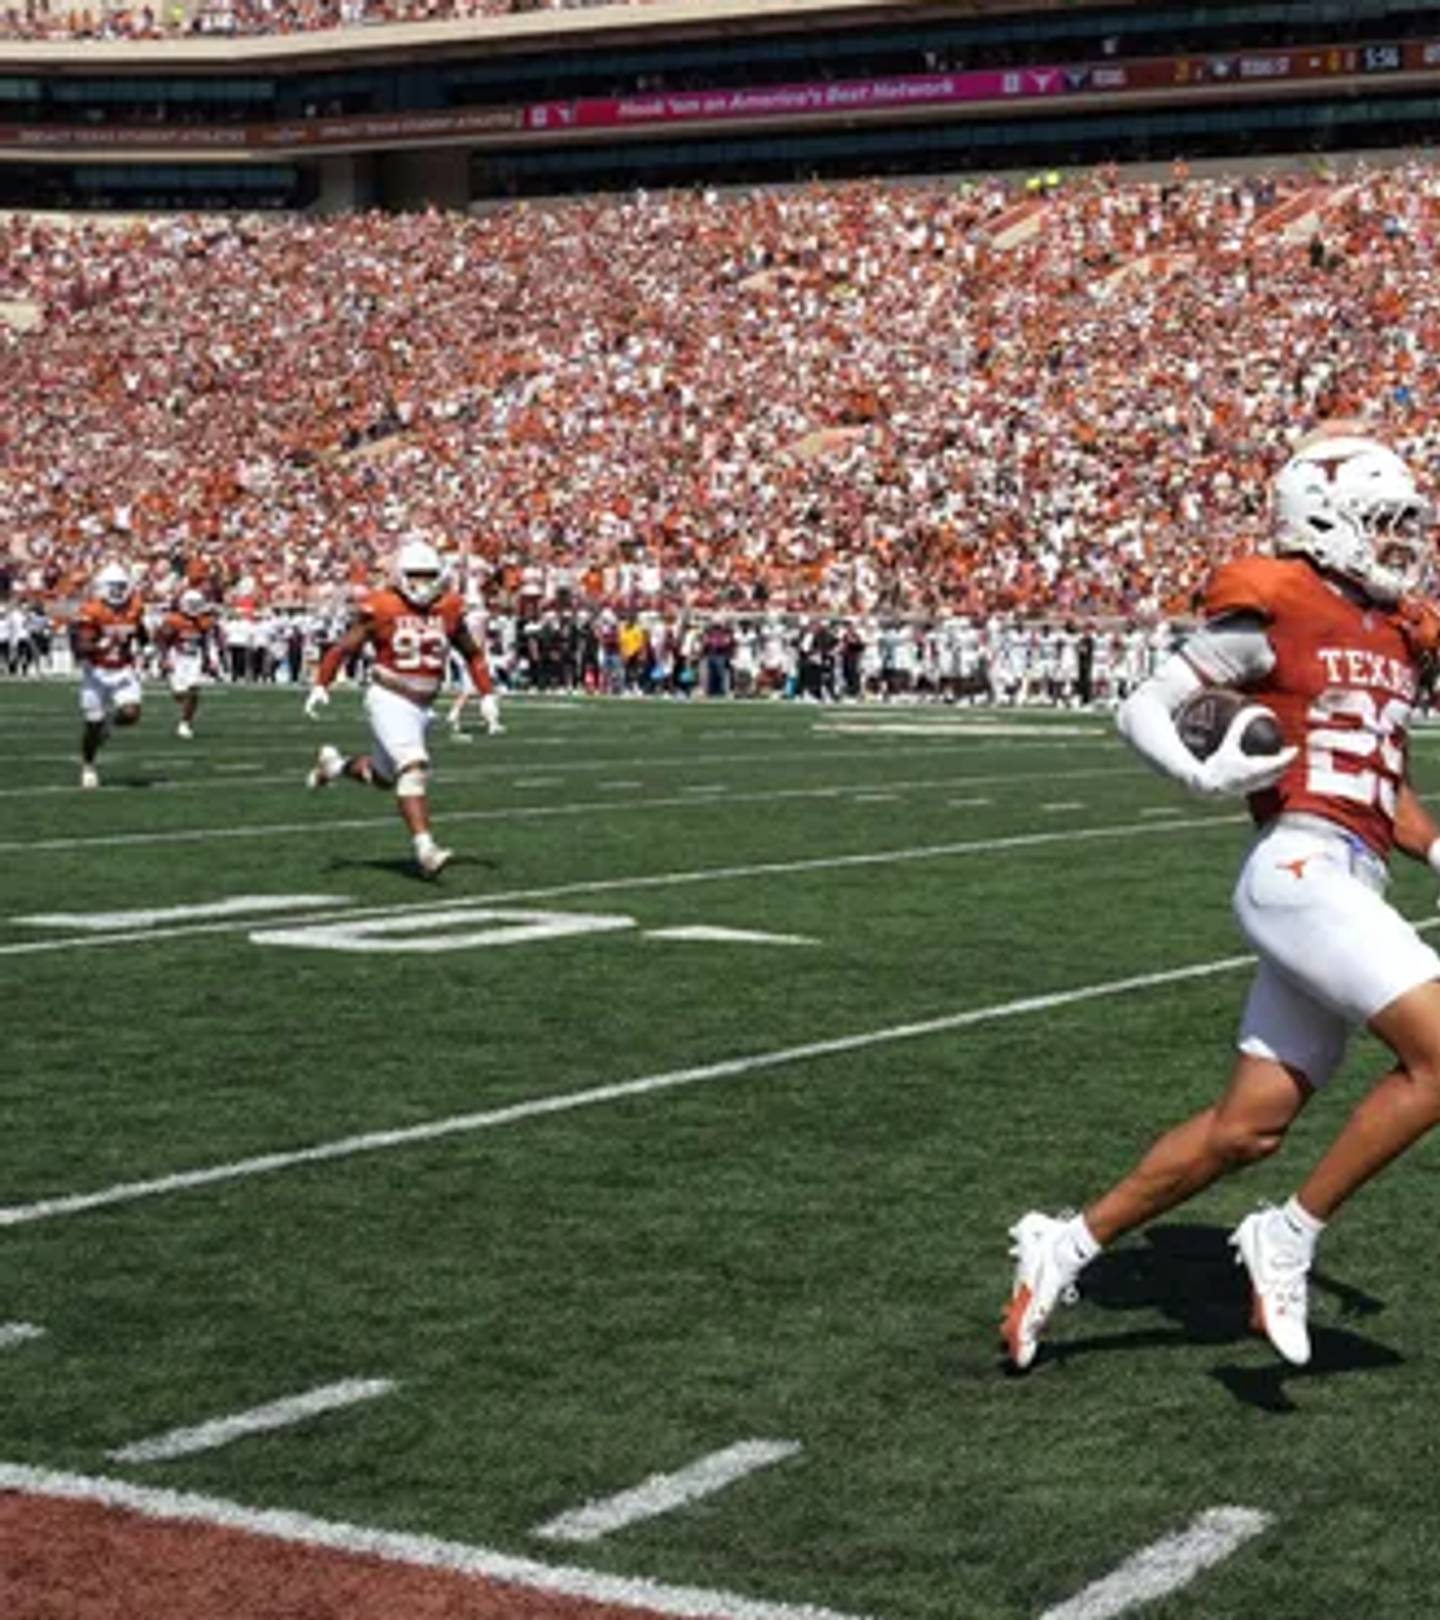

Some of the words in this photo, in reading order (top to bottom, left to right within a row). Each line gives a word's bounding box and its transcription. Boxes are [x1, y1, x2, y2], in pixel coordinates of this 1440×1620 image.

[727, 86, 822, 111] America's
[825, 84, 870, 105] Best
[871, 79, 955, 99] Network
[392, 628, 448, 670] 93
